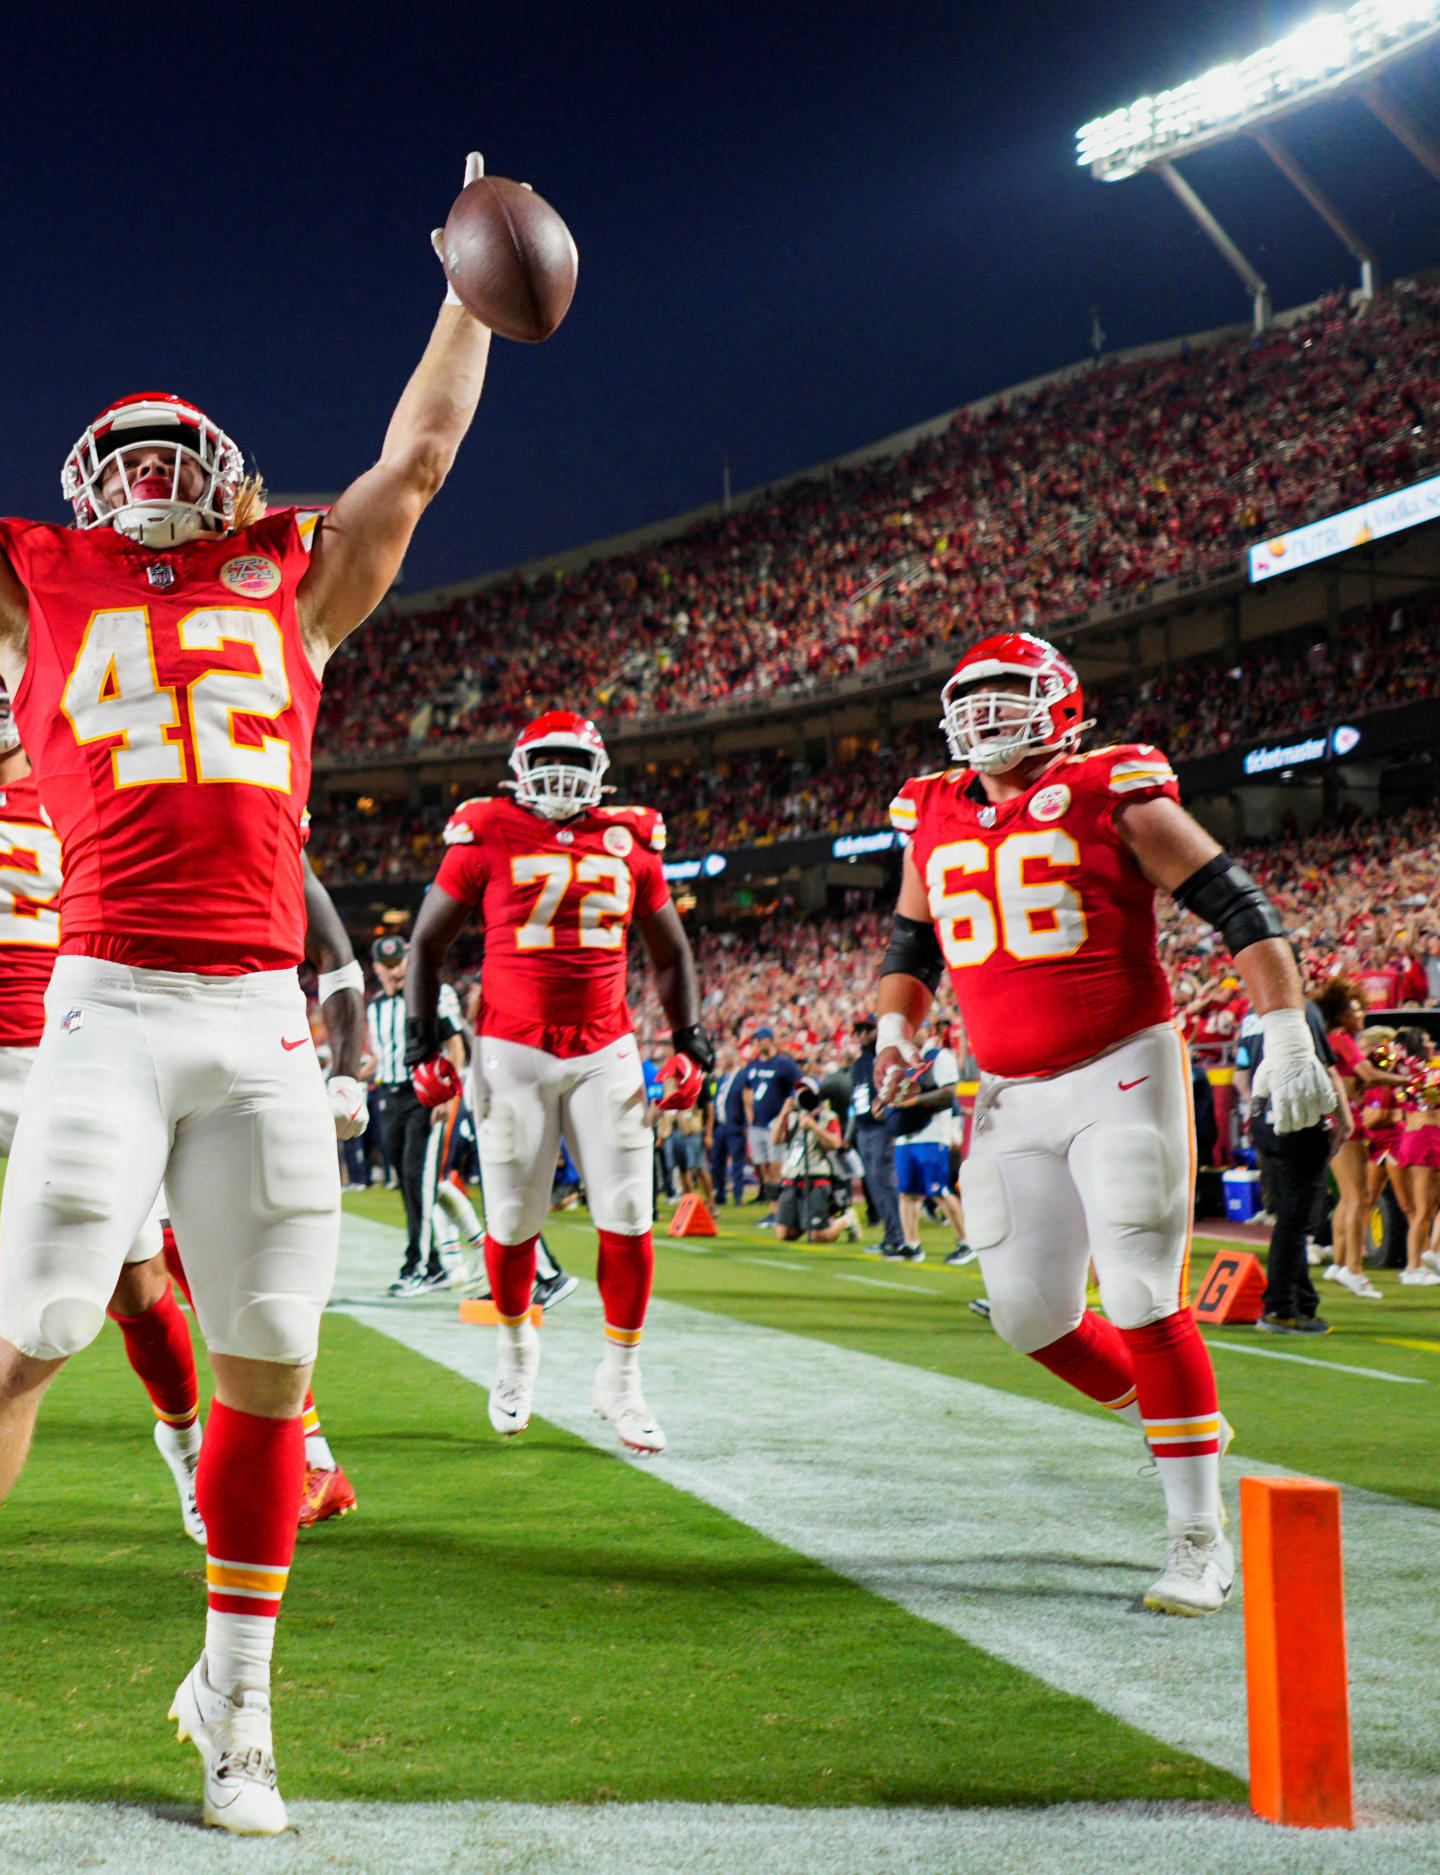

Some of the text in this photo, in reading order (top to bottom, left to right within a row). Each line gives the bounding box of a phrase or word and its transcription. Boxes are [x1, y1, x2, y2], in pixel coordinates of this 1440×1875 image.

[60, 605, 291, 795] 42
[511, 853, 632, 949] 72
[926, 828, 1088, 969] 66
[1197, 1259, 1240, 1312] G
